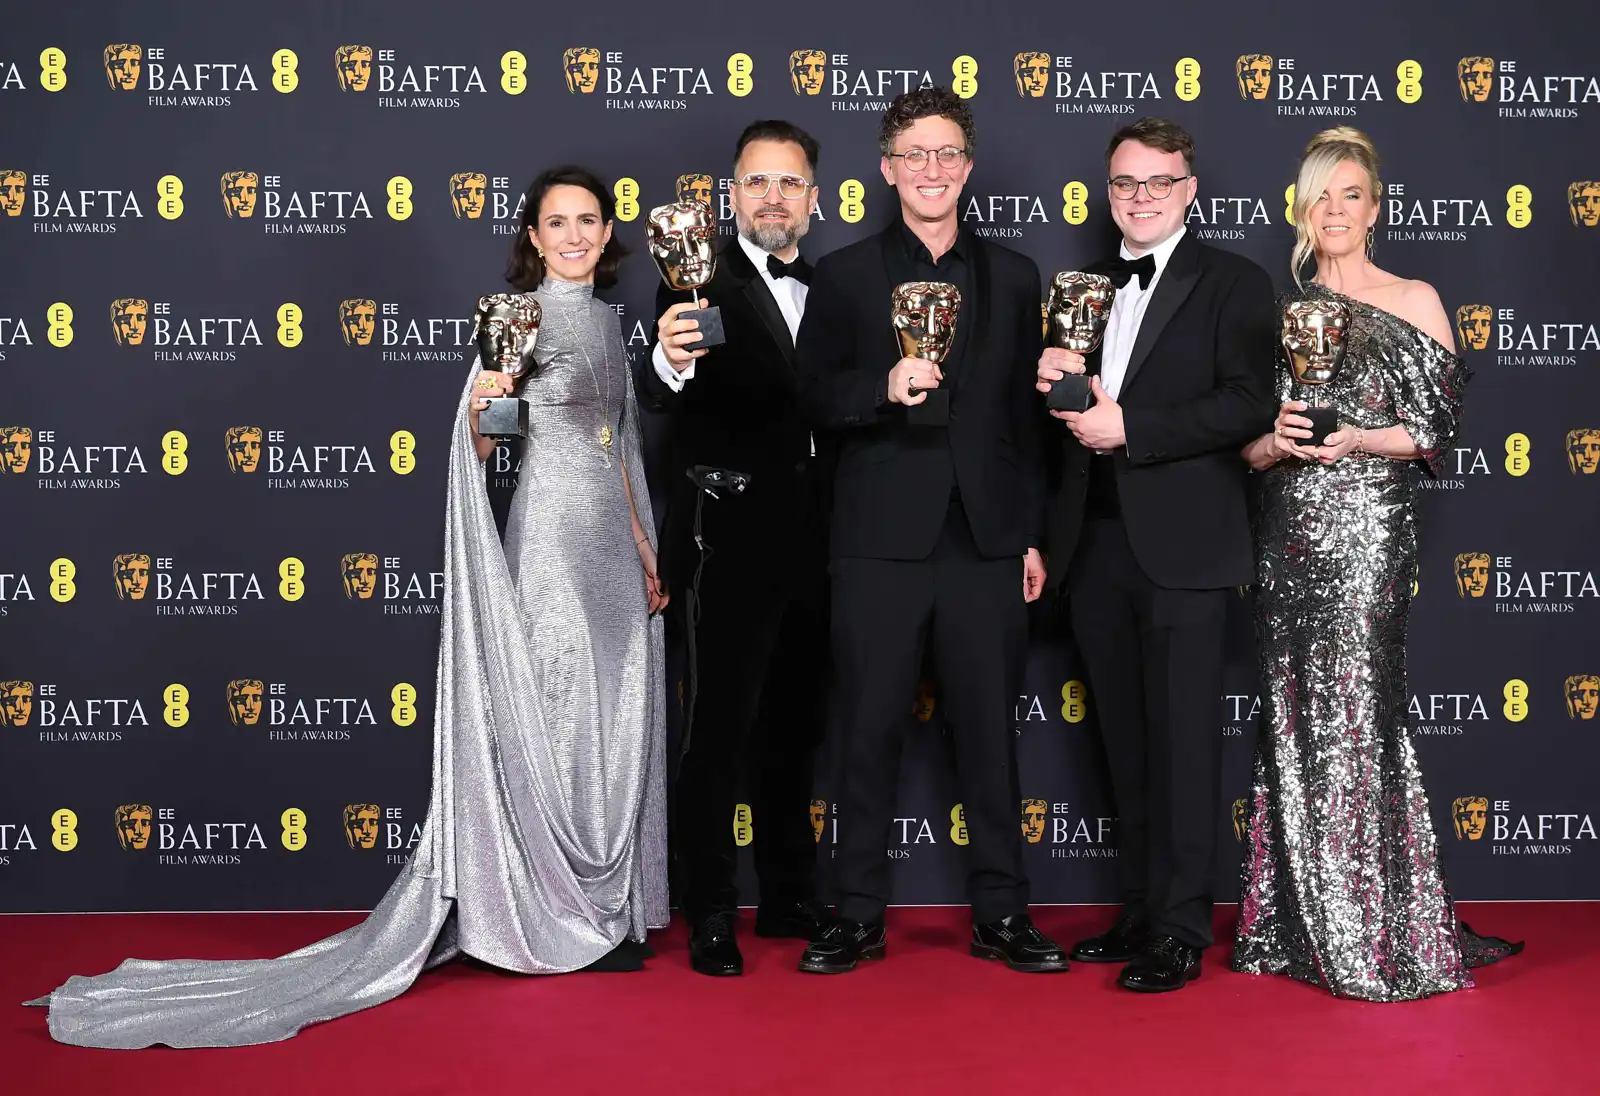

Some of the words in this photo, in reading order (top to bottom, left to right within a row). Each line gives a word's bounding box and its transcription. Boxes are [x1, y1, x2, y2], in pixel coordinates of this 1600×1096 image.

[148, 49, 164, 59] EE
[379, 50, 394, 60] EE
[607, 52, 622, 62] EE
[832, 55, 848, 65] EE
[1057, 57, 1072, 67] EE
[1279, 59, 1294, 69] EE
[1500, 61, 1515, 72] EE
[148, 64, 258, 91] BAFTA
[378, 65, 487, 92] BAFTA
[606, 67, 713, 94] BAFTA
[1056, 72, 1161, 99] BAFTA
[1278, 74, 1383, 101] BAFTA
[149, 96, 176, 106] FILM
[181, 96, 230, 106] AWARDS
[379, 98, 406, 107] FILM
[411, 98, 460, 107] AWARDS
[607, 100, 633, 109] FILM
[638, 100, 686, 109] AWARDS
[832, 102, 859, 111] FILM
[863, 102, 894, 111] AWA
[1056, 104, 1082, 113] FILM
[1087, 104, 1134, 113] AWARDS
[1278, 106, 1304, 116] FILM
[1309, 106, 1356, 116] AWARDS
[1499, 108, 1526, 117] FILM
[1530, 108, 1578, 117] AWARDS
[33, 175, 49, 185] EE
[265, 176, 280, 187] EE
[493, 177, 509, 188] EE
[1389, 184, 1404, 195] EE
[33, 190, 143, 217] BAFTA
[264, 191, 373, 218] BAFTA
[963, 196, 1049, 222] AFTA
[1185, 198, 1271, 224] AFTA
[1388, 199, 1493, 226] BAFTA
[34, 223, 62, 232] FILM
[66, 223, 116, 232] AWARDS
[265, 224, 292, 233] FILM
[297, 224, 346, 233] AWARDS
[720, 226, 736, 235] FIL
[976, 228, 1022, 237] AWARDS
[1197, 230, 1244, 239] AWARDS
[1388, 231, 1414, 241] FILM
[1419, 231, 1466, 241] AWARDS
[155, 303, 170, 314] EE
[383, 304, 398, 314] EE
[1499, 309, 1514, 319] EE
[154, 319, 263, 345] BAFTA
[155, 352, 182, 361] FILM
[187, 352, 235, 361] AWARDS
[383, 352, 410, 360] FILM
[414, 352, 463, 360] AWARDS
[1498, 356, 1524, 365] FILM
[1529, 356, 1576, 365] AWARDS
[39, 431, 54, 442] EE
[269, 431, 284, 441] EE
[38, 446, 147, 473] BAFTA
[268, 446, 376, 472] BAFTA
[39, 479, 66, 488] FILM
[71, 479, 120, 488] AWARDS
[269, 479, 295, 488] FILM
[300, 479, 348, 488] AWARDS
[1417, 480, 1465, 489] AWARDS
[157, 558, 172, 568] EE
[385, 557, 400, 568] EE
[1497, 557, 1511, 567] EE
[156, 573, 265, 599] BAFTA
[384, 573, 443, 599] BAF
[157, 606, 184, 615] FILM
[189, 606, 237, 615] AWARDS
[384, 605, 411, 614] FILM
[415, 605, 440, 614] AWA
[1496, 603, 1522, 612] FILM
[1526, 603, 1574, 612] AWARDS
[41, 685, 56, 695] EE
[270, 684, 285, 694] EE
[270, 699, 377, 725] BAFTA
[1408, 694, 1489, 720] AFTA
[40, 699, 149, 726] BAFTA
[270, 731, 297, 740] FILM
[302, 731, 350, 740] AWARDS
[1415, 726, 1463, 735] AWARDS
[40, 732, 67, 741] FILM
[72, 732, 121, 741] AWARDS
[1053, 803, 1068, 813] EE
[1495, 801, 1509, 810] EE
[159, 809, 174, 819] EE
[386, 808, 402, 818] EE
[1052, 818, 1112, 843] BAF
[158, 823, 267, 849] BAFTA
[887, 849, 910, 858] RDS
[1052, 849, 1079, 858] FILM
[1082, 849, 1118, 858] AWAR
[1493, 845, 1519, 854] FILM
[1524, 845, 1571, 854] AWARDS
[160, 855, 187, 864] FILM
[192, 855, 240, 864] AWARDS
